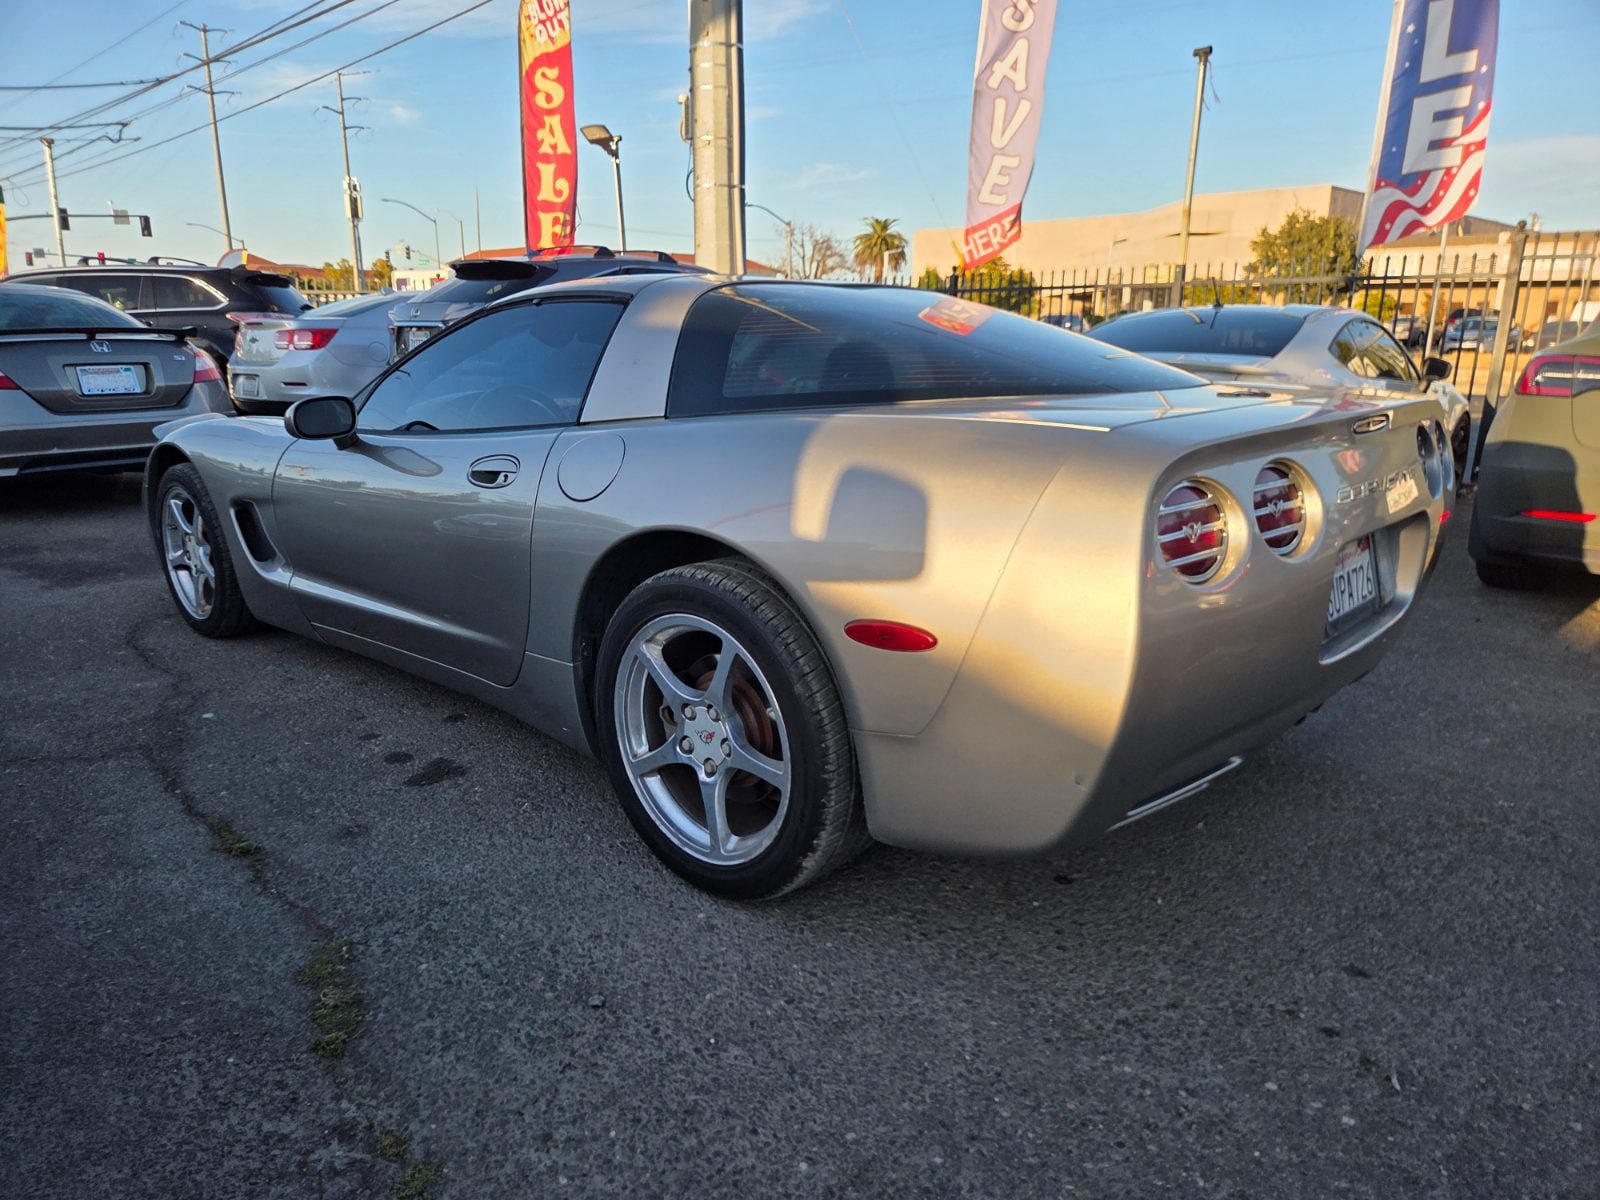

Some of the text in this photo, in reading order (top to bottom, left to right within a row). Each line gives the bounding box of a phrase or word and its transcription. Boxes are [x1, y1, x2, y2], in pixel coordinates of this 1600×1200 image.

[535, 11, 569, 44] OUT
[533, 66, 572, 250] SALE
[977, 0, 1039, 206] SAVE
[962, 213, 1020, 264] HERE
